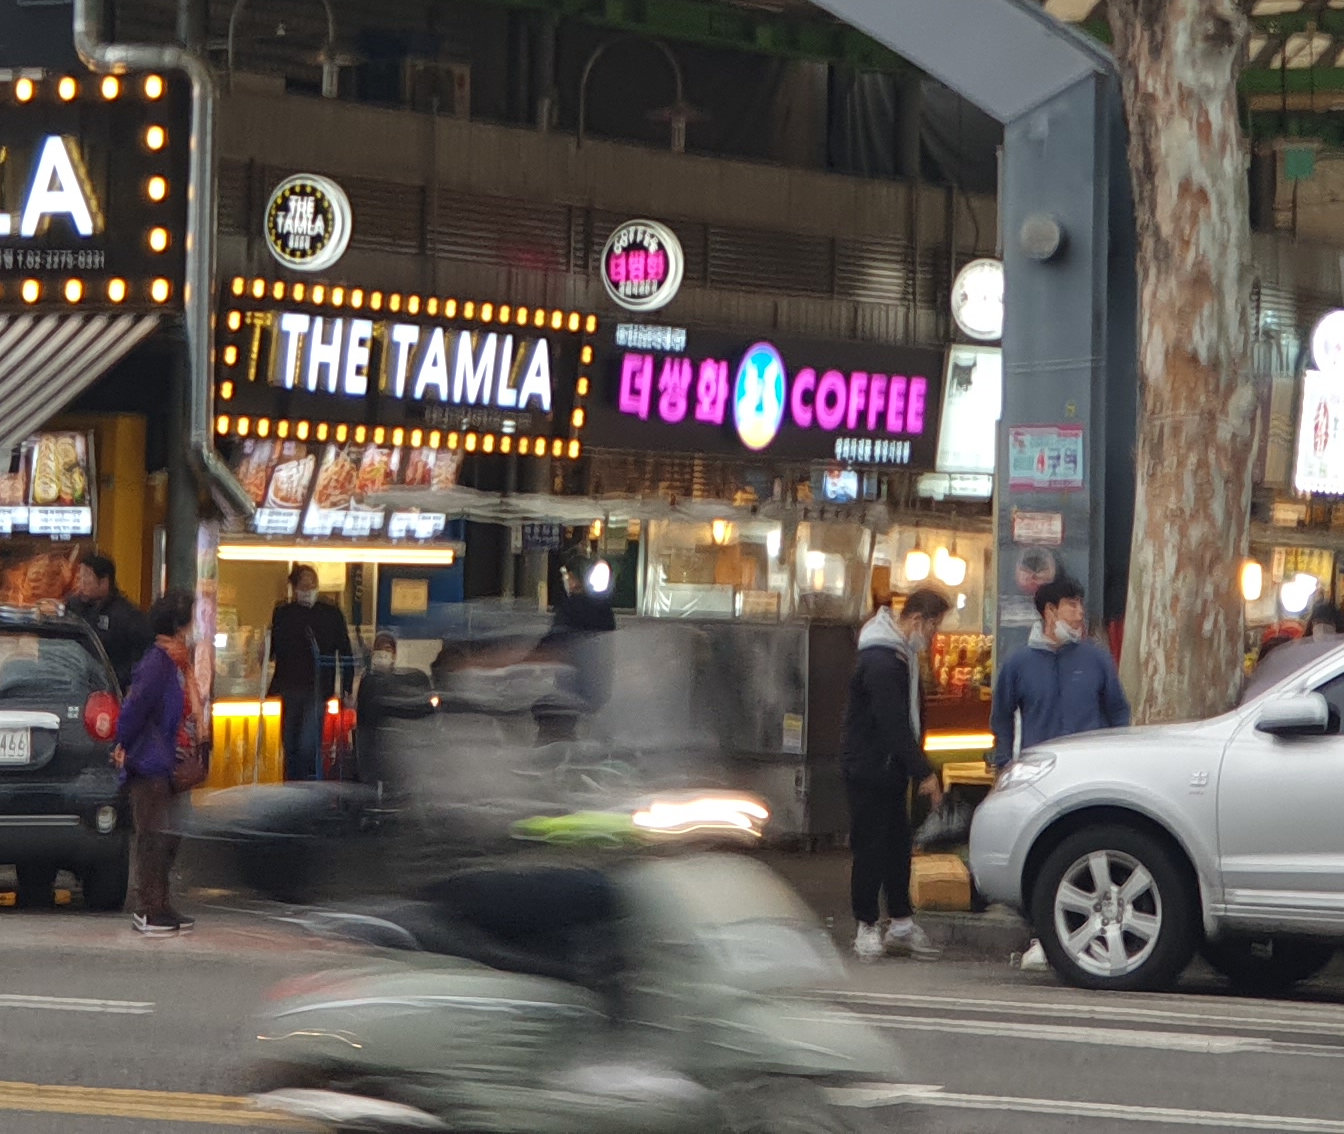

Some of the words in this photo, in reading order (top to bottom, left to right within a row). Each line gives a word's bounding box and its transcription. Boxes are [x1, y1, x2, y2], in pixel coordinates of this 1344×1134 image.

[277, 211, 324, 236] TAMLA
[289, 195, 315, 219] THE
[279, 312, 374, 396] THE
[391, 323, 553, 412] TAMLA
[619, 352, 728, 424] 더쌍화
[791, 367, 927, 434] COFFEE
